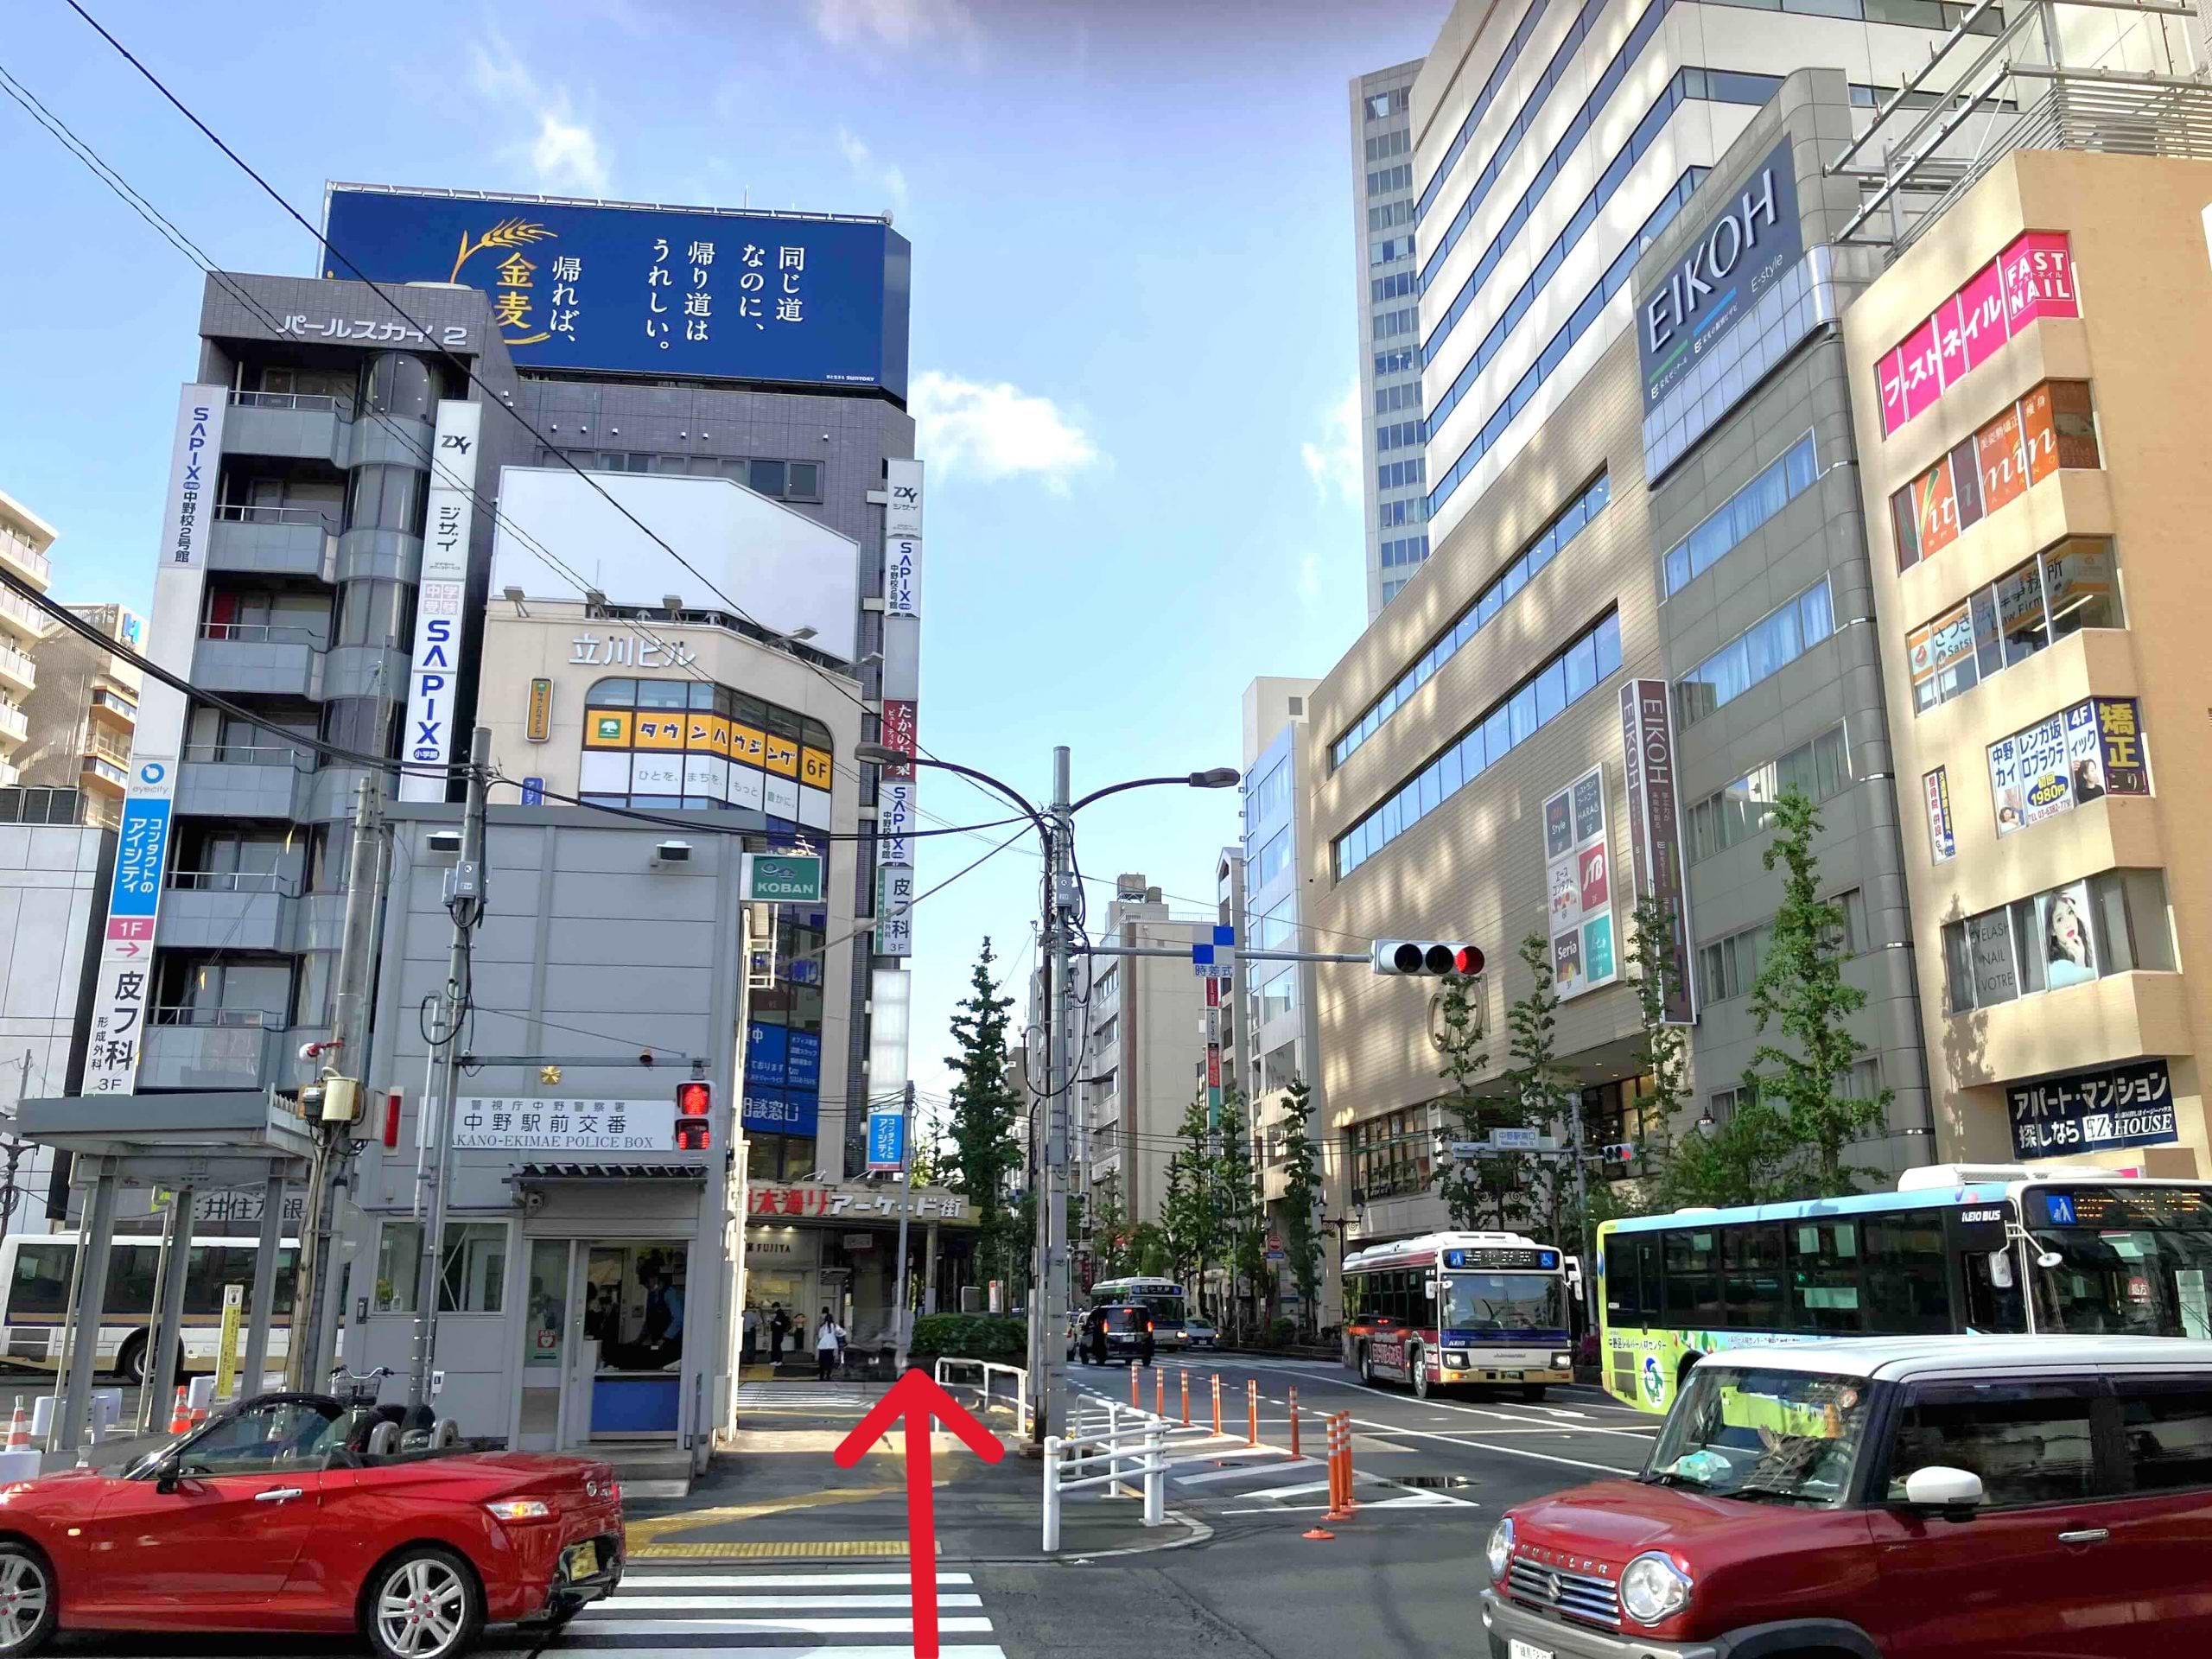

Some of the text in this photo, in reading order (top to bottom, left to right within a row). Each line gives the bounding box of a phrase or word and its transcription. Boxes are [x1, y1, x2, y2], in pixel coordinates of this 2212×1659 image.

[1648, 167, 1777, 353] EIKOH
[1751, 253, 1783, 294] E-style
[2007, 251, 2064, 288] FAST
[495, 251, 537, 330] 金麦
[549, 256, 583, 344] 帰れば、
[645, 237, 673, 351] うれしい。
[684, 240, 715, 342] 帰り道は
[737, 244, 767, 332] なのに、
[775, 245, 804, 323] 同じ道
[2011, 278, 2070, 315] NAIL
[276, 314, 467, 346] パールスカイ 2
[184, 407, 210, 480] SAPIX
[442, 435, 472, 454] ZXY
[893, 486, 918, 503] ZXY
[175, 490, 198, 563] 中野校2号館
[437, 506, 461, 552] ジザイ
[899, 542, 912, 602] SAPIX
[569, 633, 696, 668] 立川ビル
[416, 620, 451, 746] SAPIX
[2071, 707, 2088, 728] 4F
[2099, 702, 2140, 767] 矯正
[641, 722, 827, 778] タウンハウジング 6F
[1624, 702, 1639, 790] EIKOH
[1643, 699, 1669, 784] EIKOH
[1993, 720, 2062, 765] 中野 レンガ坂
[2022, 741, 2063, 778] ロプラクテ
[132, 786, 168, 796] eyecity
[2031, 784, 2065, 805] 1980円
[893, 787, 906, 850] SAPIX
[122, 818, 148, 893] アイシティ
[141, 819, 162, 893] コンタクトの
[1583, 855, 1603, 891] JTB
[757, 882, 814, 894] KOBAN
[892, 878, 911, 939] 皮フ科
[120, 922, 143, 936] 1F
[1970, 922, 2009, 944] EYELASH
[1195, 964, 1233, 976] 時差式
[1558, 942, 1577, 961] Seria
[1983, 952, 2005, 966] NAIL
[1981, 972, 2013, 992] VOTRE
[105, 971, 143, 1071] 皮フ科
[91, 1016, 109, 1071] 形成外科
[99, 1077, 122, 1091] 3F
[2014, 1072, 2167, 1120] アパート・マンション
[464, 1113, 626, 1134] 中野駅前交番
[566, 1135, 620, 1149] POLICE
[624, 1136, 653, 1149] BOX
[877, 1118, 888, 1158] アイシティ
[2018, 1120, 2080, 1149] 探しなら
[2114, 1114, 2173, 1137] HOUSE
[1961, 1211, 2000, 1222] KEIO BUS
[757, 1244, 791, 1253] FUJIYA
